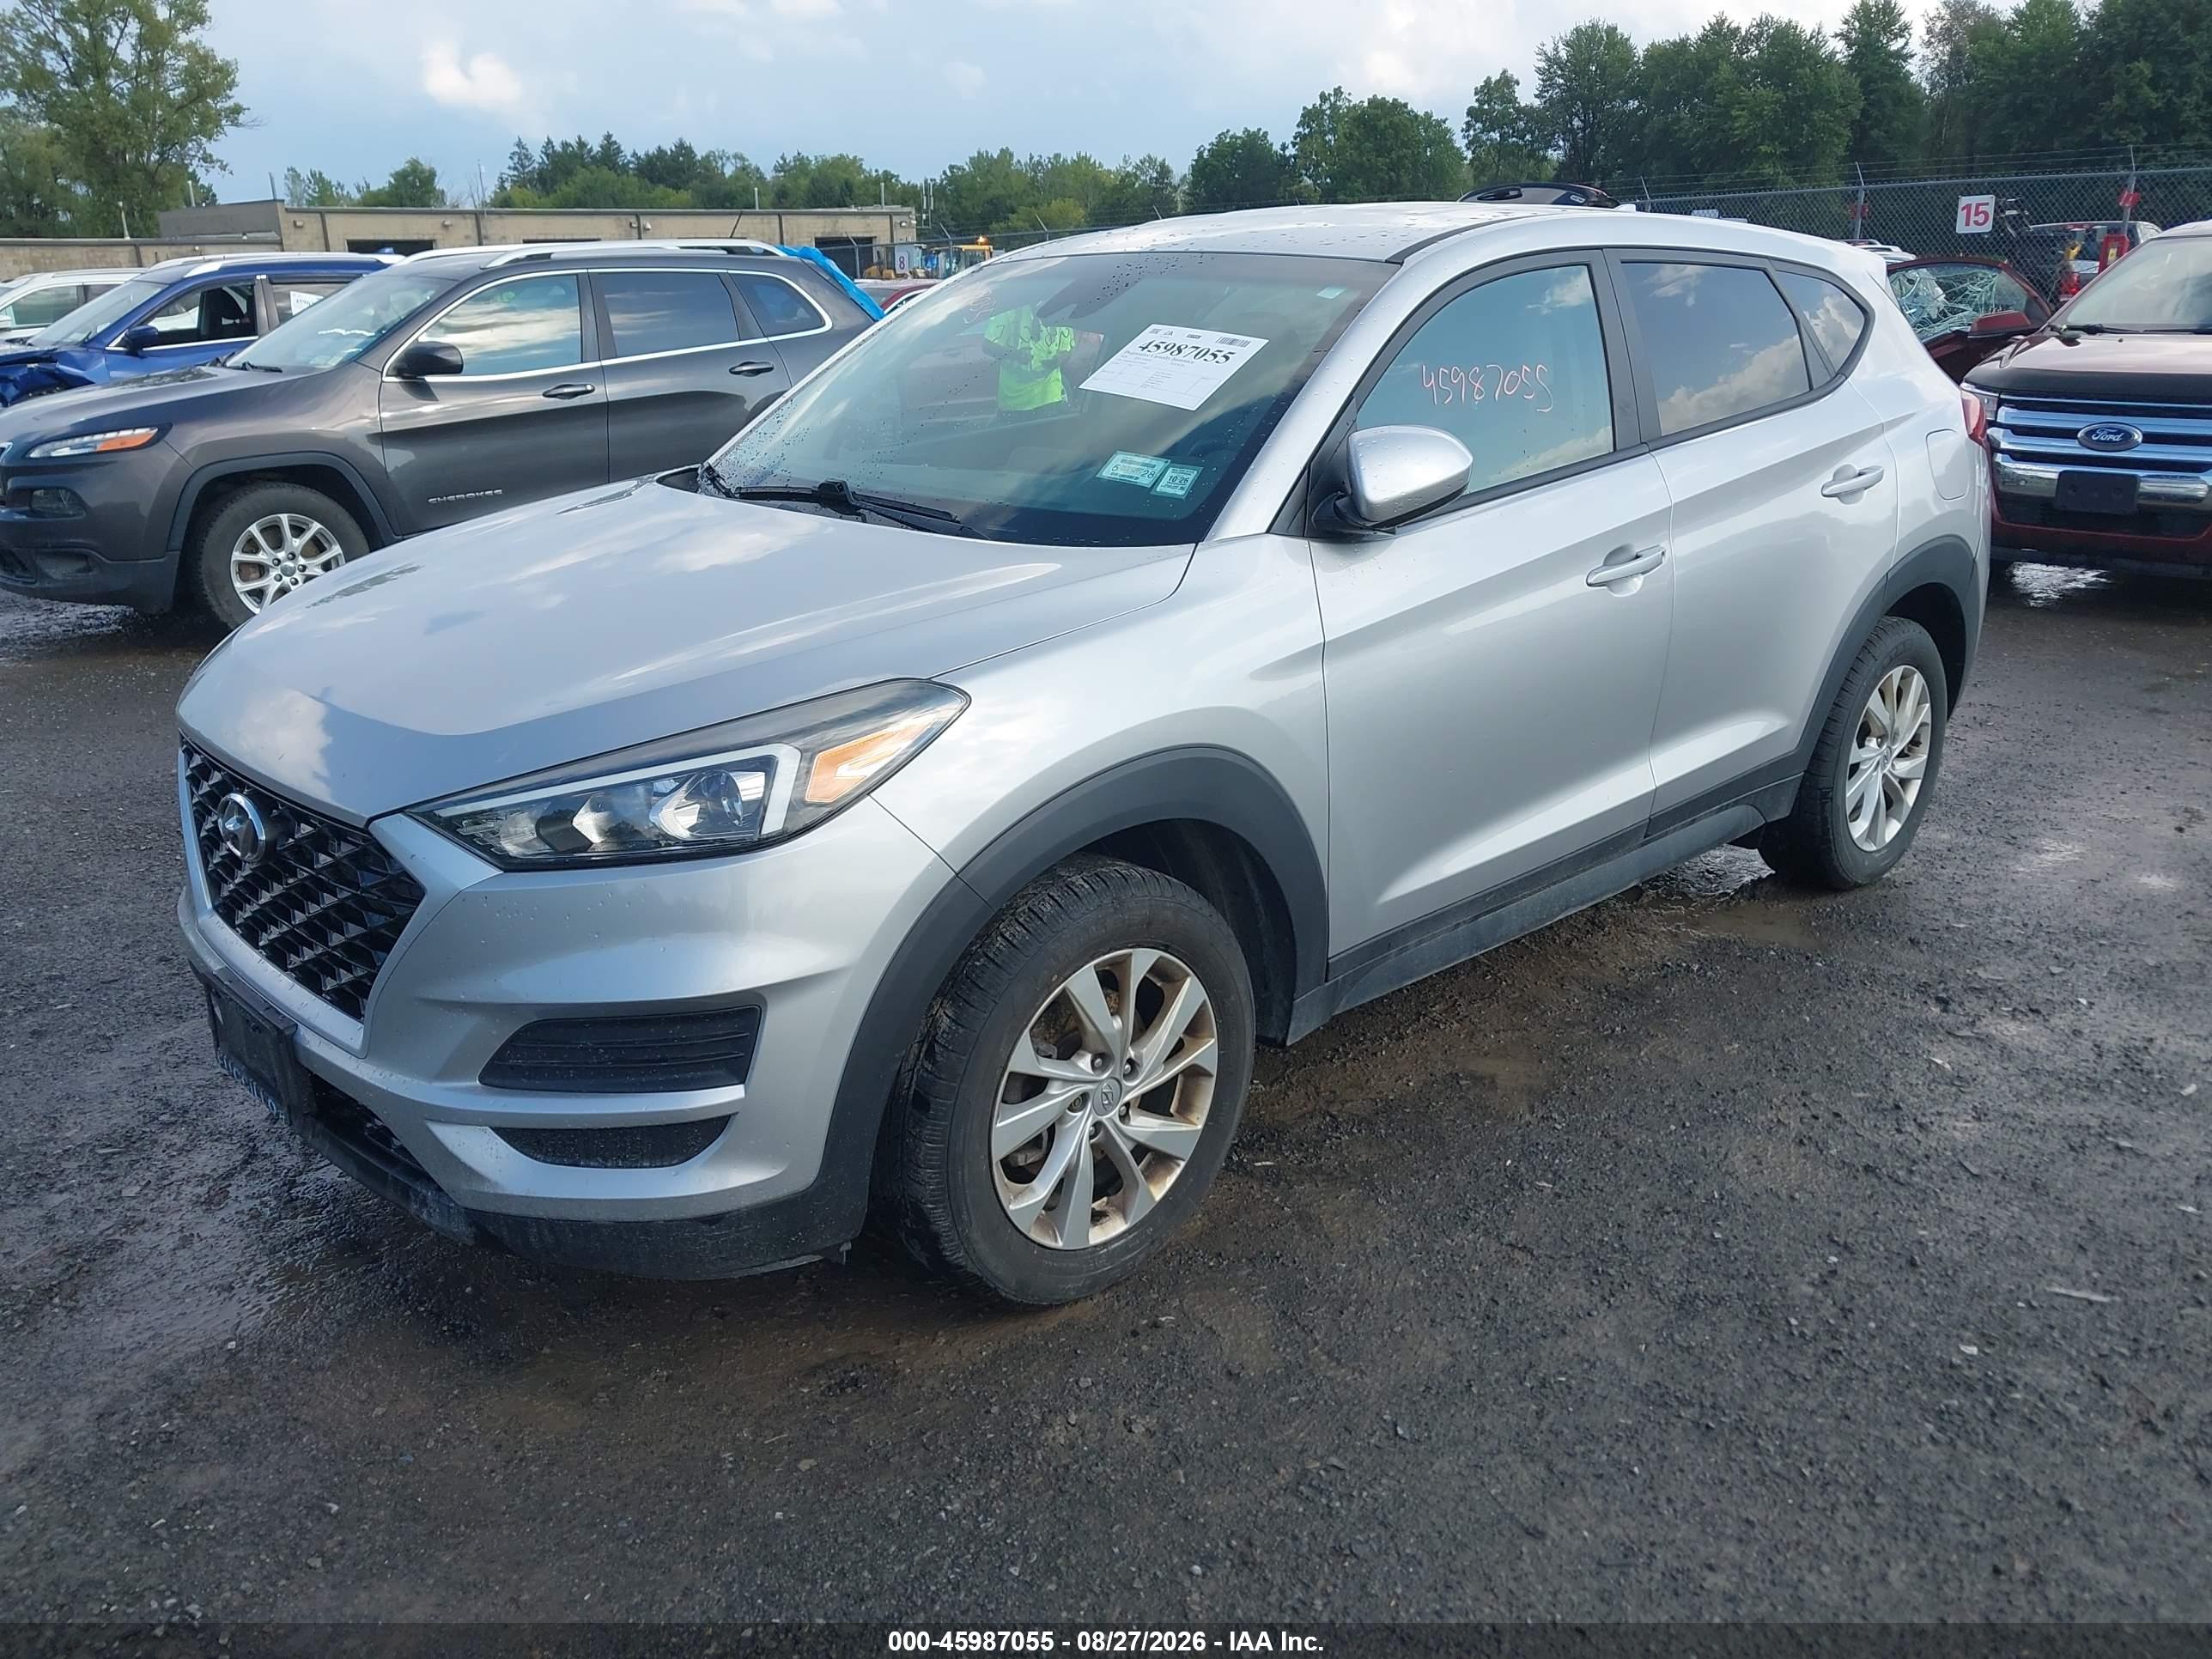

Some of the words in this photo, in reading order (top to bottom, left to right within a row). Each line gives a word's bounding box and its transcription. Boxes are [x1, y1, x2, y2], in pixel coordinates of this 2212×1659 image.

[1960, 202, 1990, 228] 15
[898, 255, 906, 270] 8
[1138, 339, 1237, 365] 45987055
[1422, 364, 1553, 412] 45987055
[2091, 428, 2125, 441] Ford
[428, 489, 502, 503] CHEROKEE
